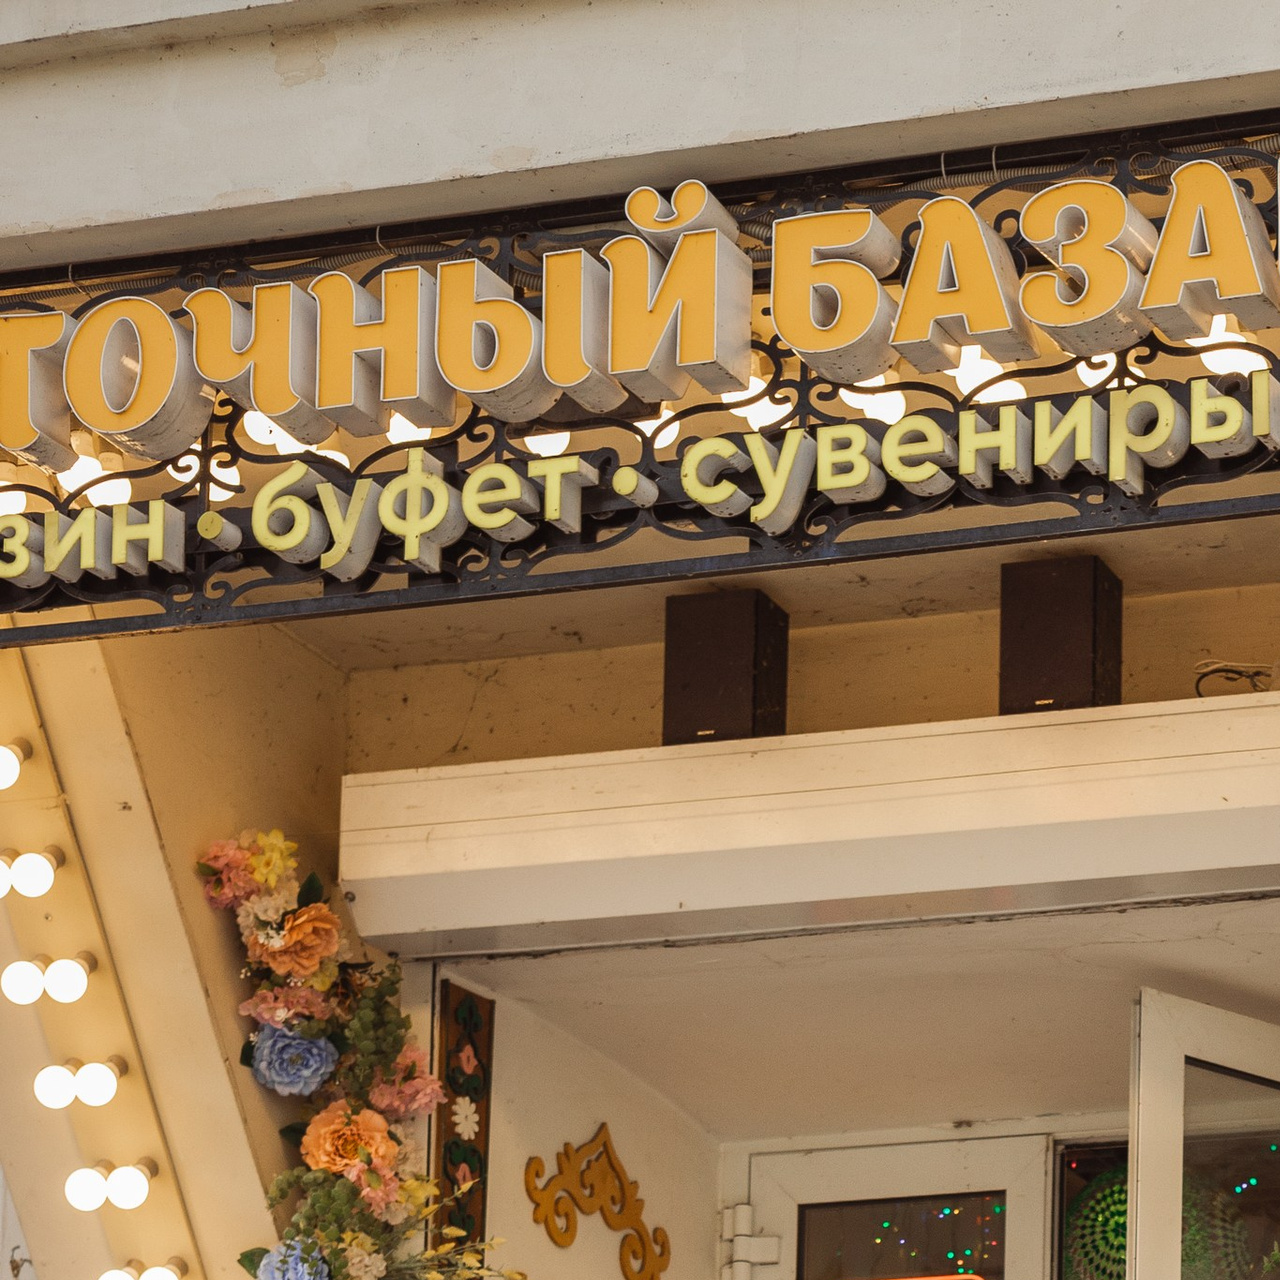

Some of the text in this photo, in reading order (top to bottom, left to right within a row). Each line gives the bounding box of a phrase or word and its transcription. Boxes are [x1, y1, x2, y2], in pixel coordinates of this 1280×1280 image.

[0, 499, 165, 579] зин
[251, 447, 586, 570] буфет
[680, 369, 1272, 524] сувениры
